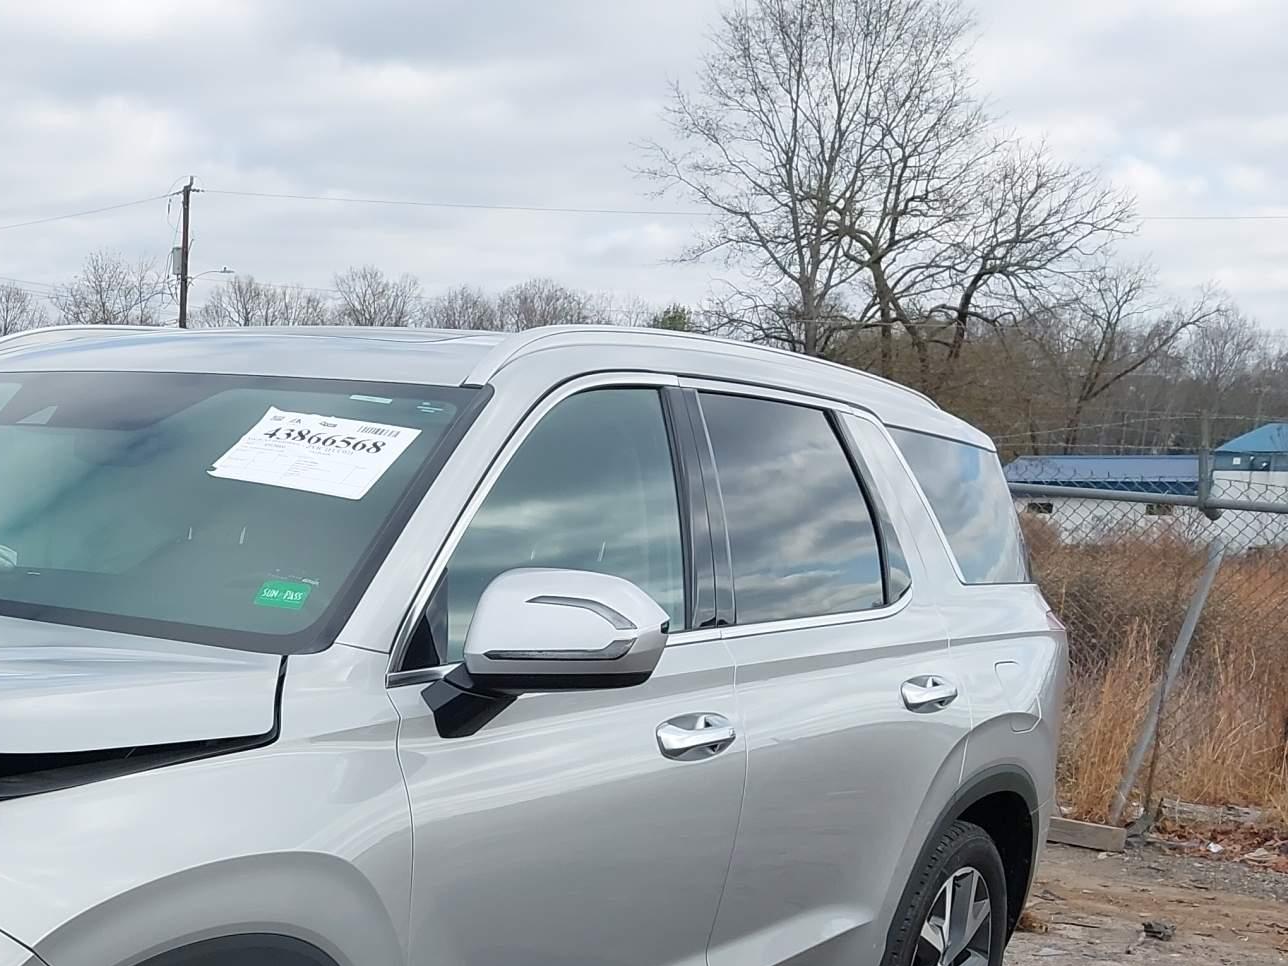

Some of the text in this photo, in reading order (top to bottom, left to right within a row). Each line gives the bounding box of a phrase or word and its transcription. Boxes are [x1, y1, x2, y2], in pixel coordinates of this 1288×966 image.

[264, 426, 387, 454] 43866568
[262, 588, 303, 600] SUN PASS
